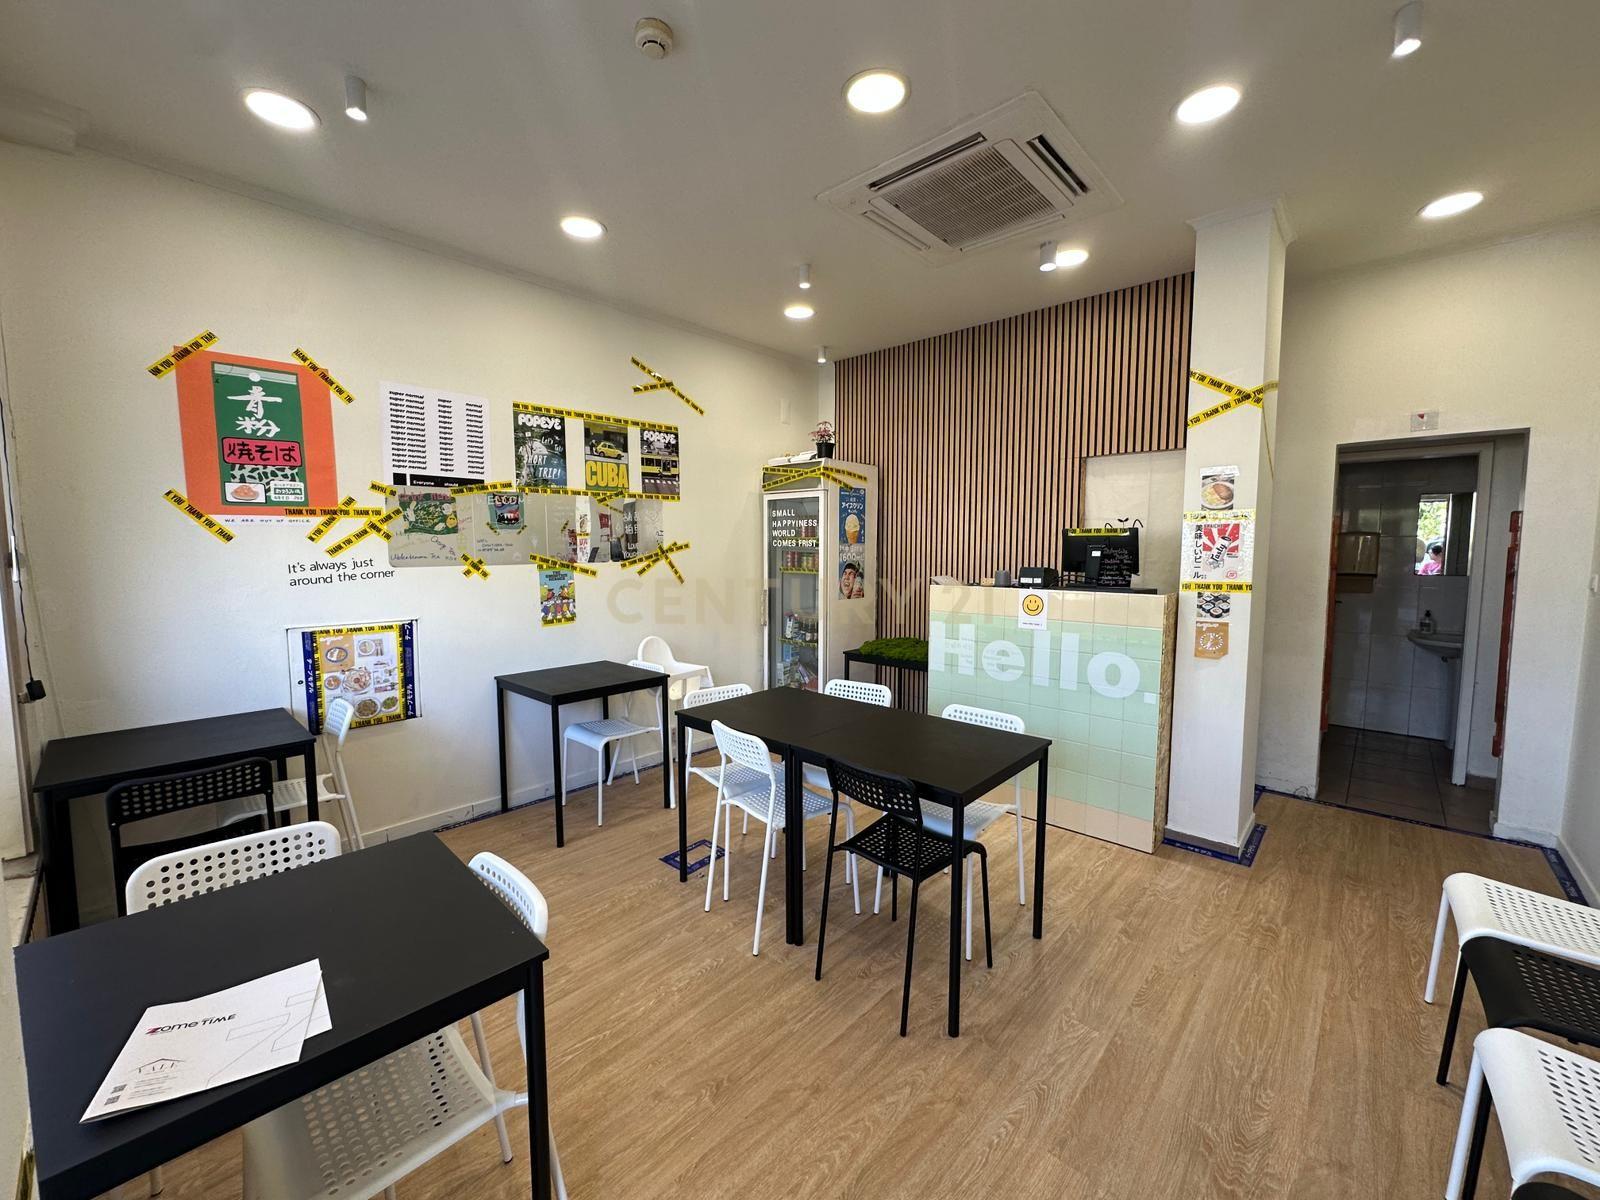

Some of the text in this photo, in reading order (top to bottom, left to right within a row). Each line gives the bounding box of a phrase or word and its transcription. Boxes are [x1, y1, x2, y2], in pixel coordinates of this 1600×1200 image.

[159, 340, 203, 369] YOU THANK YOU
[307, 362, 319, 371] YOU
[319, 372, 335, 386] THANK
[334, 385, 344, 395] YOU
[1196, 373, 1234, 393] YOU THANK YOU
[1190, 416, 1200, 425] YOU
[1202, 408, 1220, 419] THANK
[1220, 402, 1231, 411] YOU
[1252, 388, 1264, 397] YOU
[518, 414, 561, 430] POPEYE
[643, 431, 676, 444] POPEYE
[227, 441, 298, 462] 焼そば
[539, 468, 560, 478] TRIP!
[586, 460, 628, 487] CUBA
[171, 495, 185, 505] YOU
[184, 504, 205, 520] THANK
[202, 518, 216, 528] YOU
[378, 508, 403, 525] THANK YOU
[772, 509, 795, 517] SMALL
[312, 528, 324, 537] YOU
[327, 528, 369, 556] THANK YOU THANK
[1210, 544, 1228, 562] Tasty
[288, 558, 374, 574] It's always just
[290, 570, 395, 586] around the corner
[930, 620, 1156, 704] Hello.
